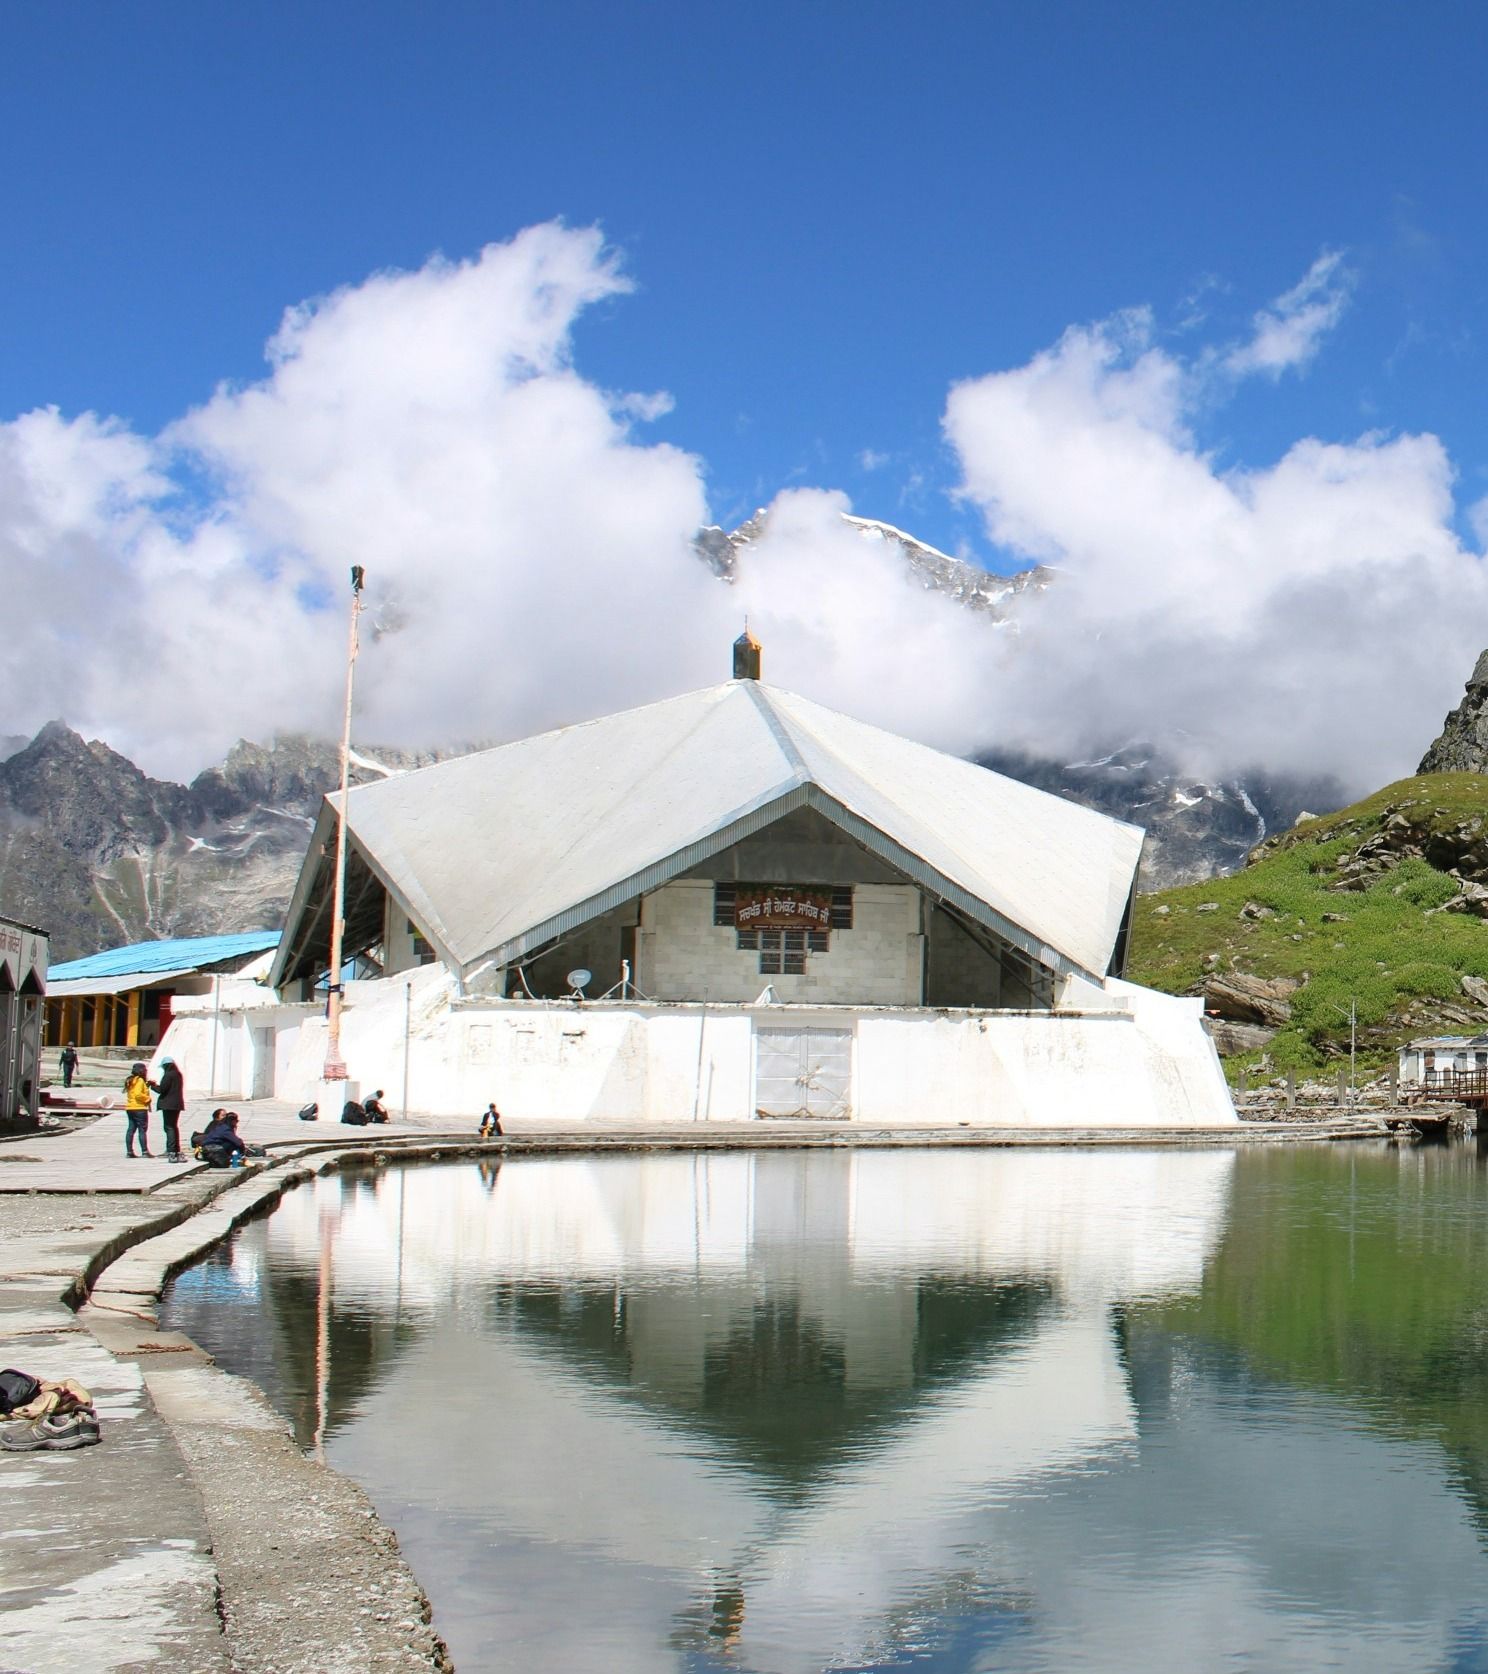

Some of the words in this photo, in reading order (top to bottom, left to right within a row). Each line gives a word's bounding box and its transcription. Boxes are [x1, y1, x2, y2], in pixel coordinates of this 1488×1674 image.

[774, 897, 796, 916] ਹੇਮਕੁੰਟ
[797, 900, 819, 920] ਸਾਹਿਬ
[820, 907, 830, 924] ਜੀ
